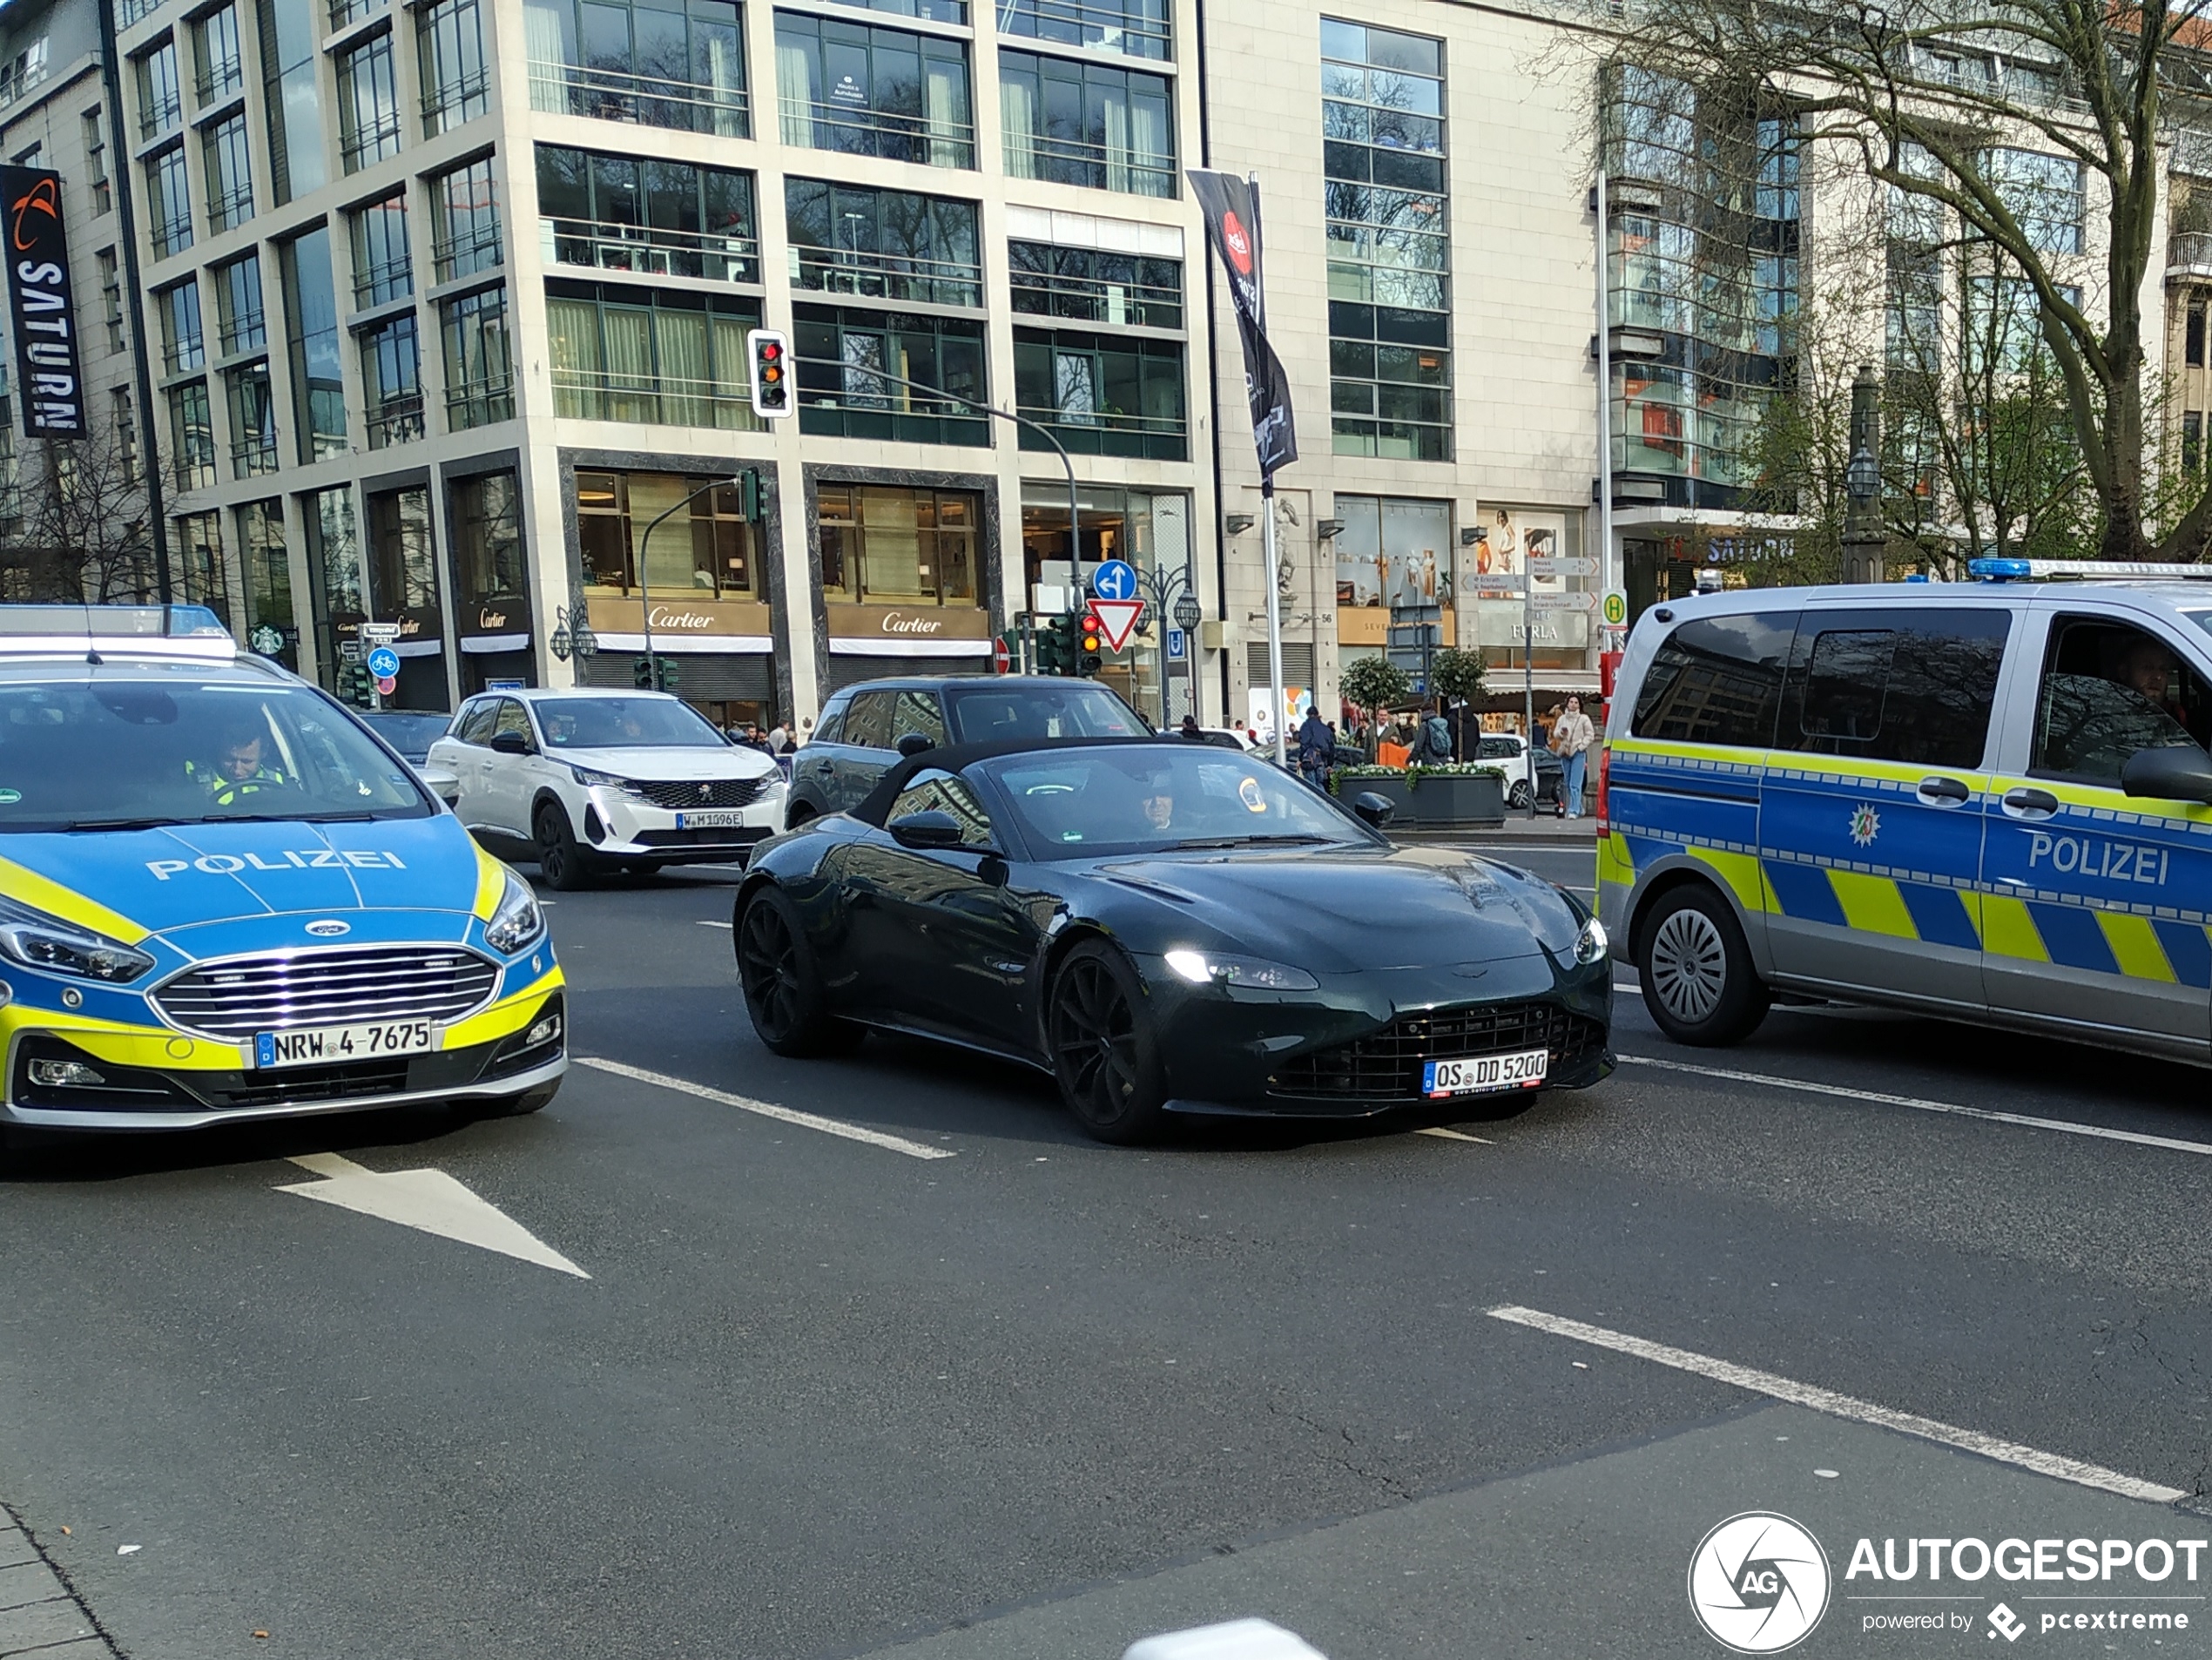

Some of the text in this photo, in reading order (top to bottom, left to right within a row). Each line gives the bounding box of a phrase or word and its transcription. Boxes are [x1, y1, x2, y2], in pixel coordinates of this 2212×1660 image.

[17, 260, 78, 429] SATURN
[481, 607, 507, 629] Cartier
[649, 606, 714, 628] Cartier
[1322, 614, 1332, 623] 56
[1609, 599, 1620, 618] H
[883, 612, 941, 633] Cartier
[1511, 624, 1558, 640] FURLA
[1170, 633, 1181, 654] U
[684, 815, 691, 826] W
[145, 850, 408, 881] POLIZEI
[2029, 833, 2168, 886] POLIZEI
[262, 1053, 270, 1062] D
[275, 1032, 323, 1062] NRW
[1438, 1054, 1546, 1087] OS DD 5200
